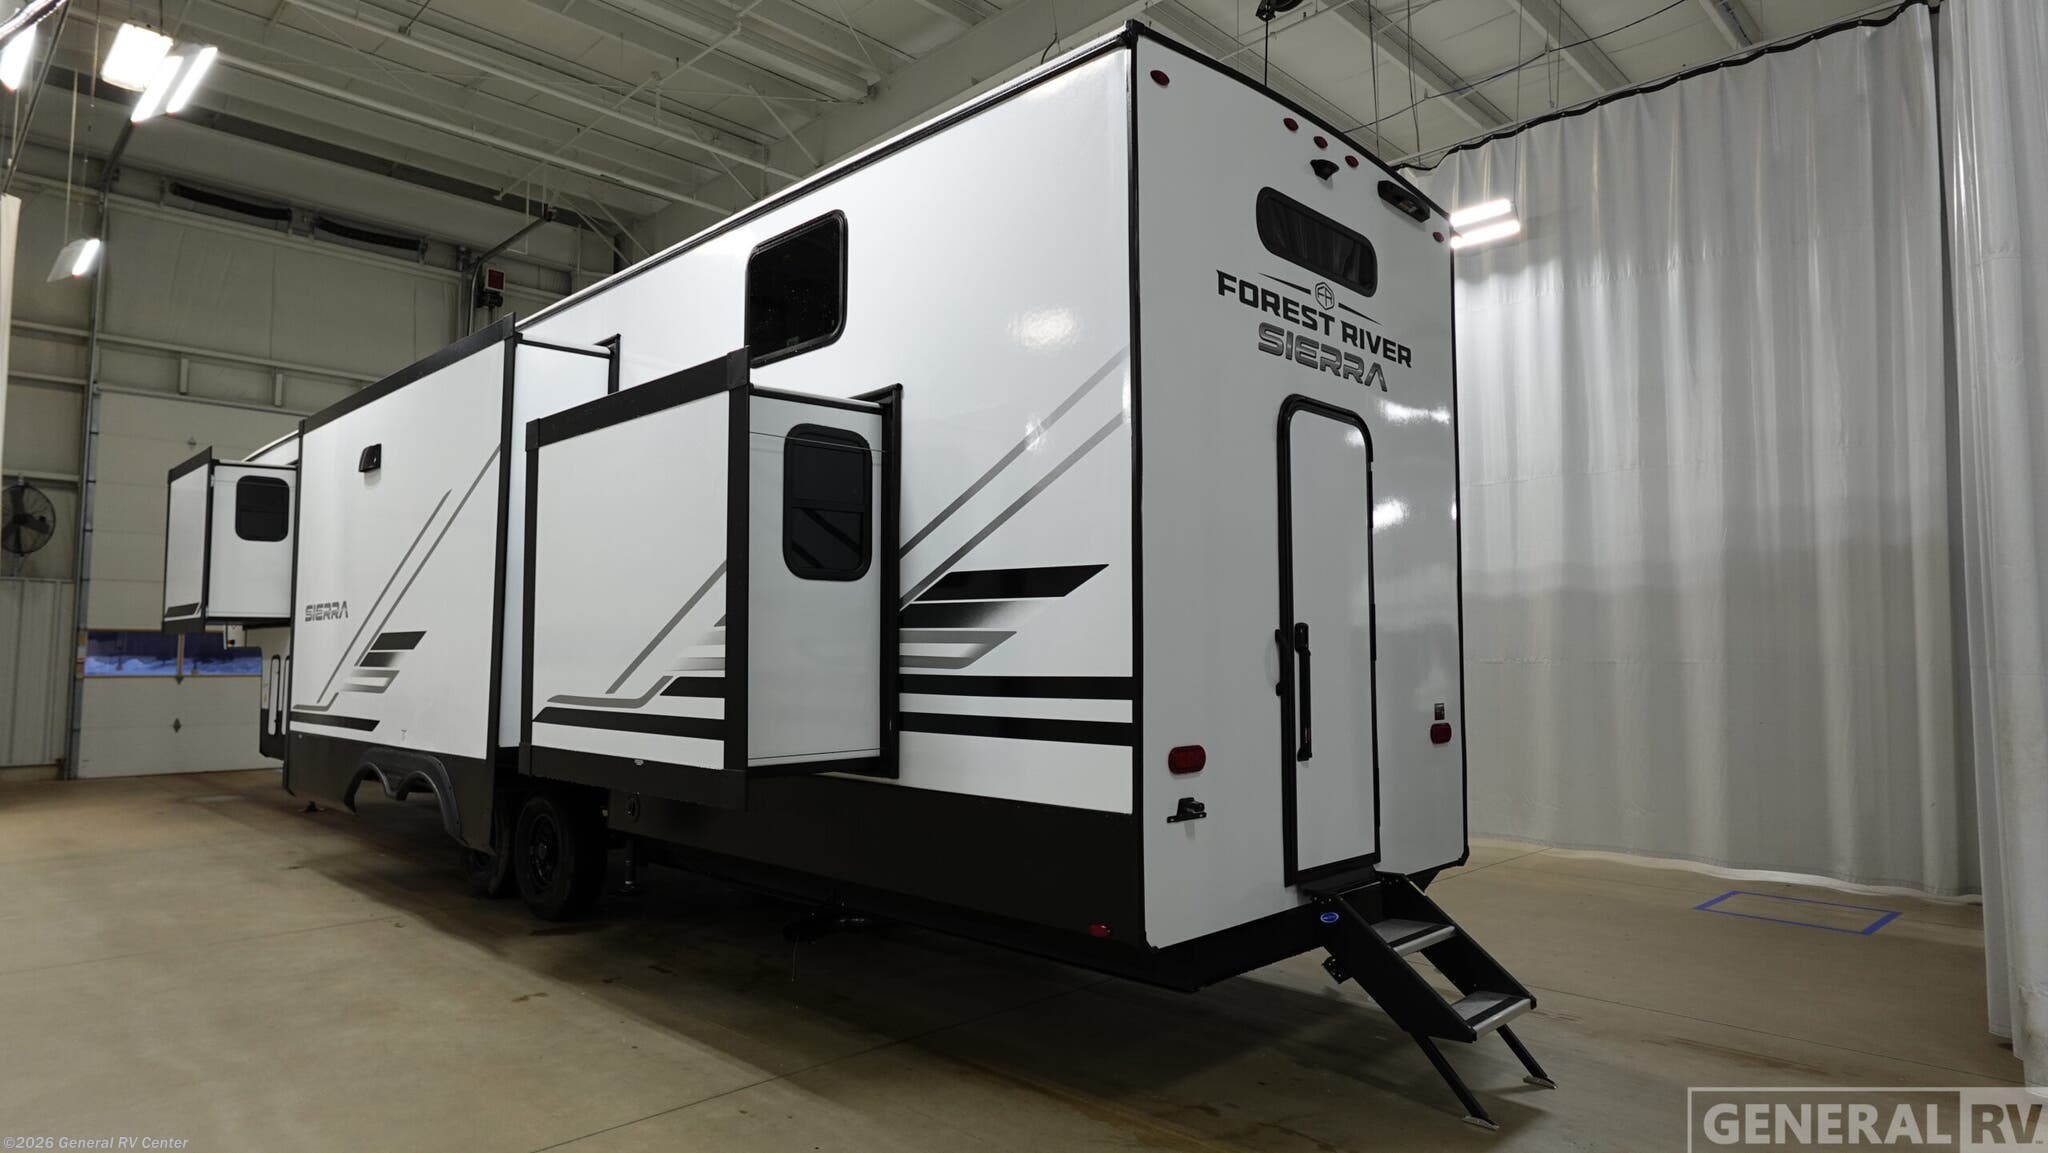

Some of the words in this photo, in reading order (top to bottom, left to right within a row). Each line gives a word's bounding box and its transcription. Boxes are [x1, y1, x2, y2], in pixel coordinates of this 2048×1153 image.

[1216, 269, 1335, 337] FOREST
[1341, 320, 1412, 368] RIVER
[1258, 322, 1388, 392] SIERRA
[305, 601, 348, 621] SIERRA
